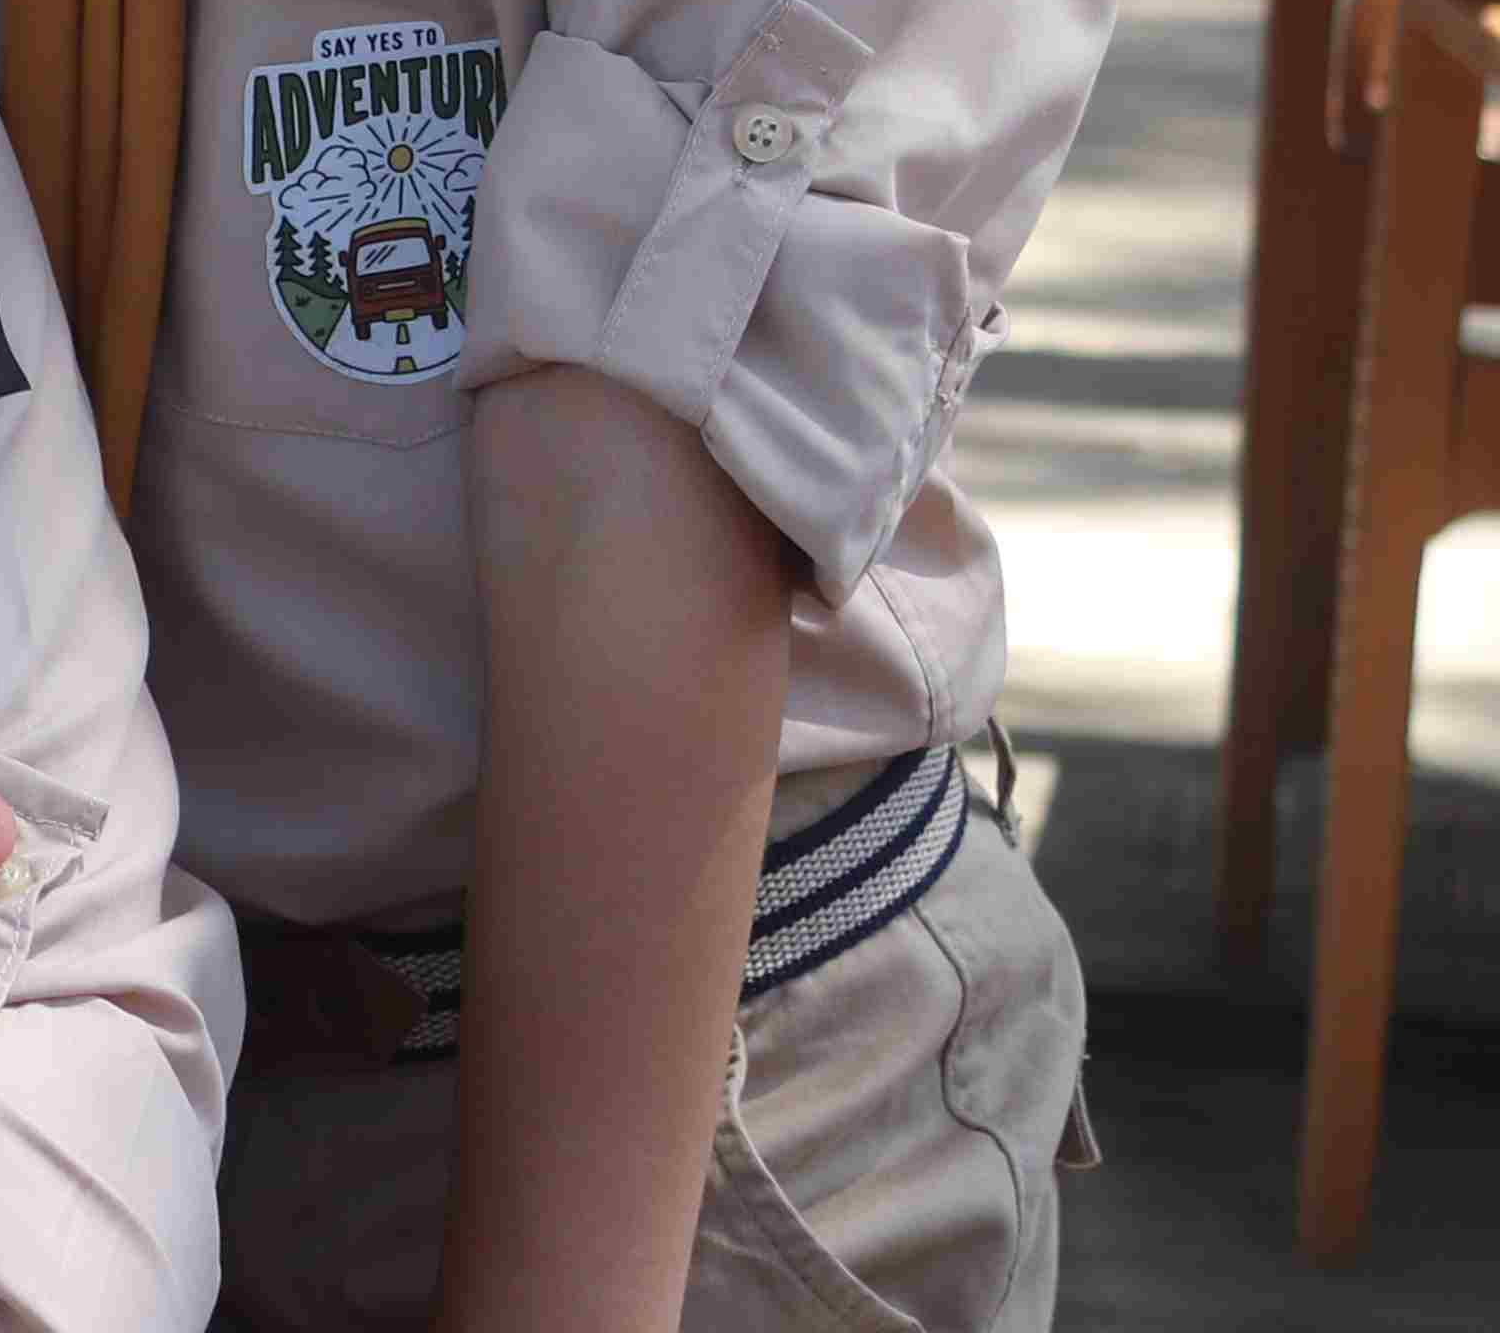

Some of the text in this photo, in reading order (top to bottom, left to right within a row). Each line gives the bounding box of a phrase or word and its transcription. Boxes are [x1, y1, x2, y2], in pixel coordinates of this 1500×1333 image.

[320, 28, 437, 58] SAY YES TO
